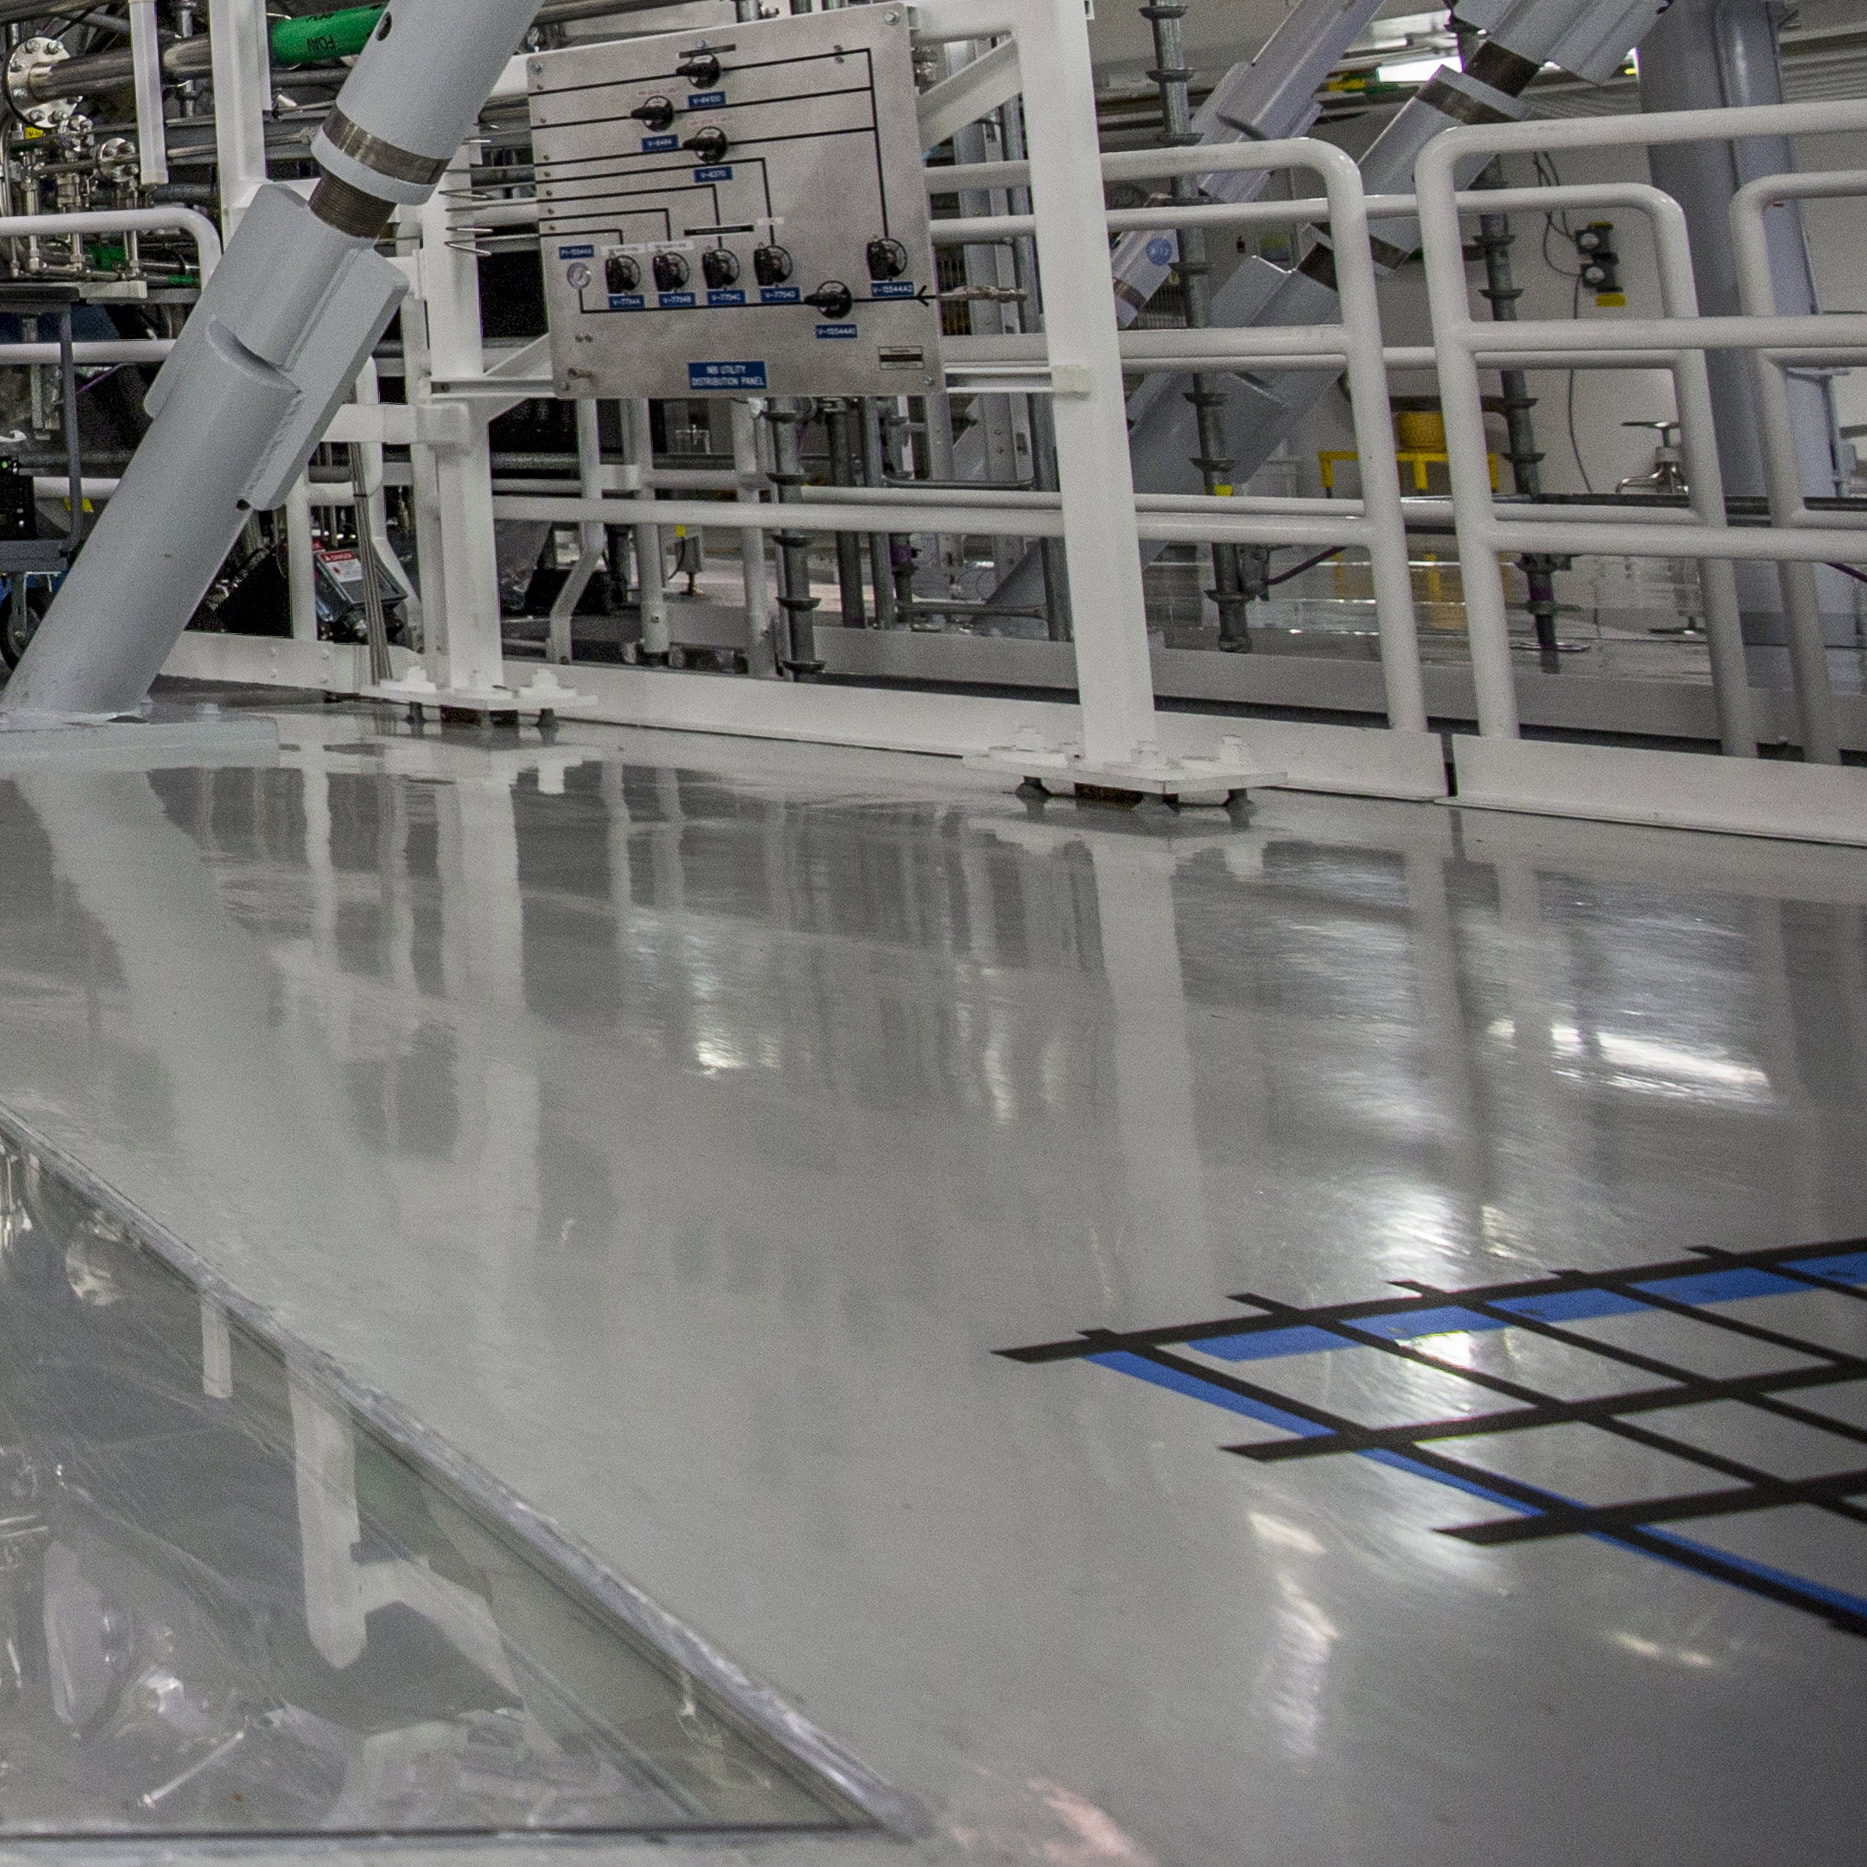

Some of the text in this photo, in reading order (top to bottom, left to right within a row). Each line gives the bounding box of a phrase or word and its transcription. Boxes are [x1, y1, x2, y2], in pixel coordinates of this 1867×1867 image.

[719, 364, 747, 375] UTILITY
[691, 376, 765, 386] DISTRIBUTION PANEL
